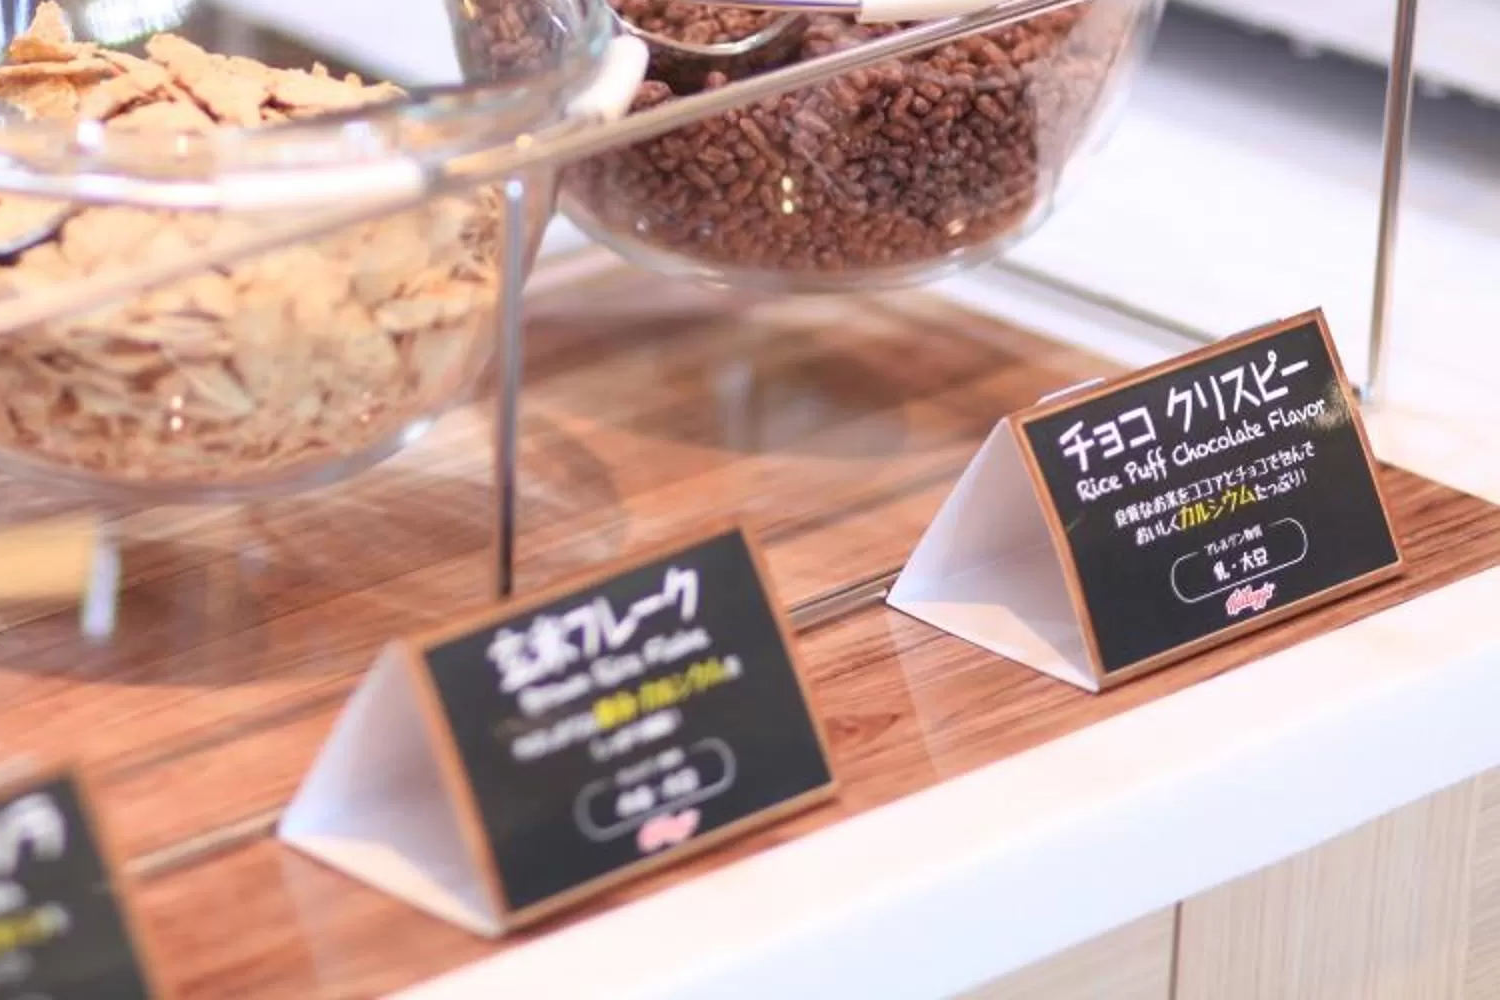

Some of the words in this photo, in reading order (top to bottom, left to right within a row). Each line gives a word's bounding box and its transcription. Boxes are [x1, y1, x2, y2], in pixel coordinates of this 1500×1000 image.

[1058, 406, 1157, 473] チョコ
[1166, 349, 1309, 433] クリスピー
[1076, 476, 1123, 502] Rice
[1124, 446, 1167, 482] Puff
[1172, 420, 1265, 467] Chocolate
[1267, 399, 1325, 432] Flavor
